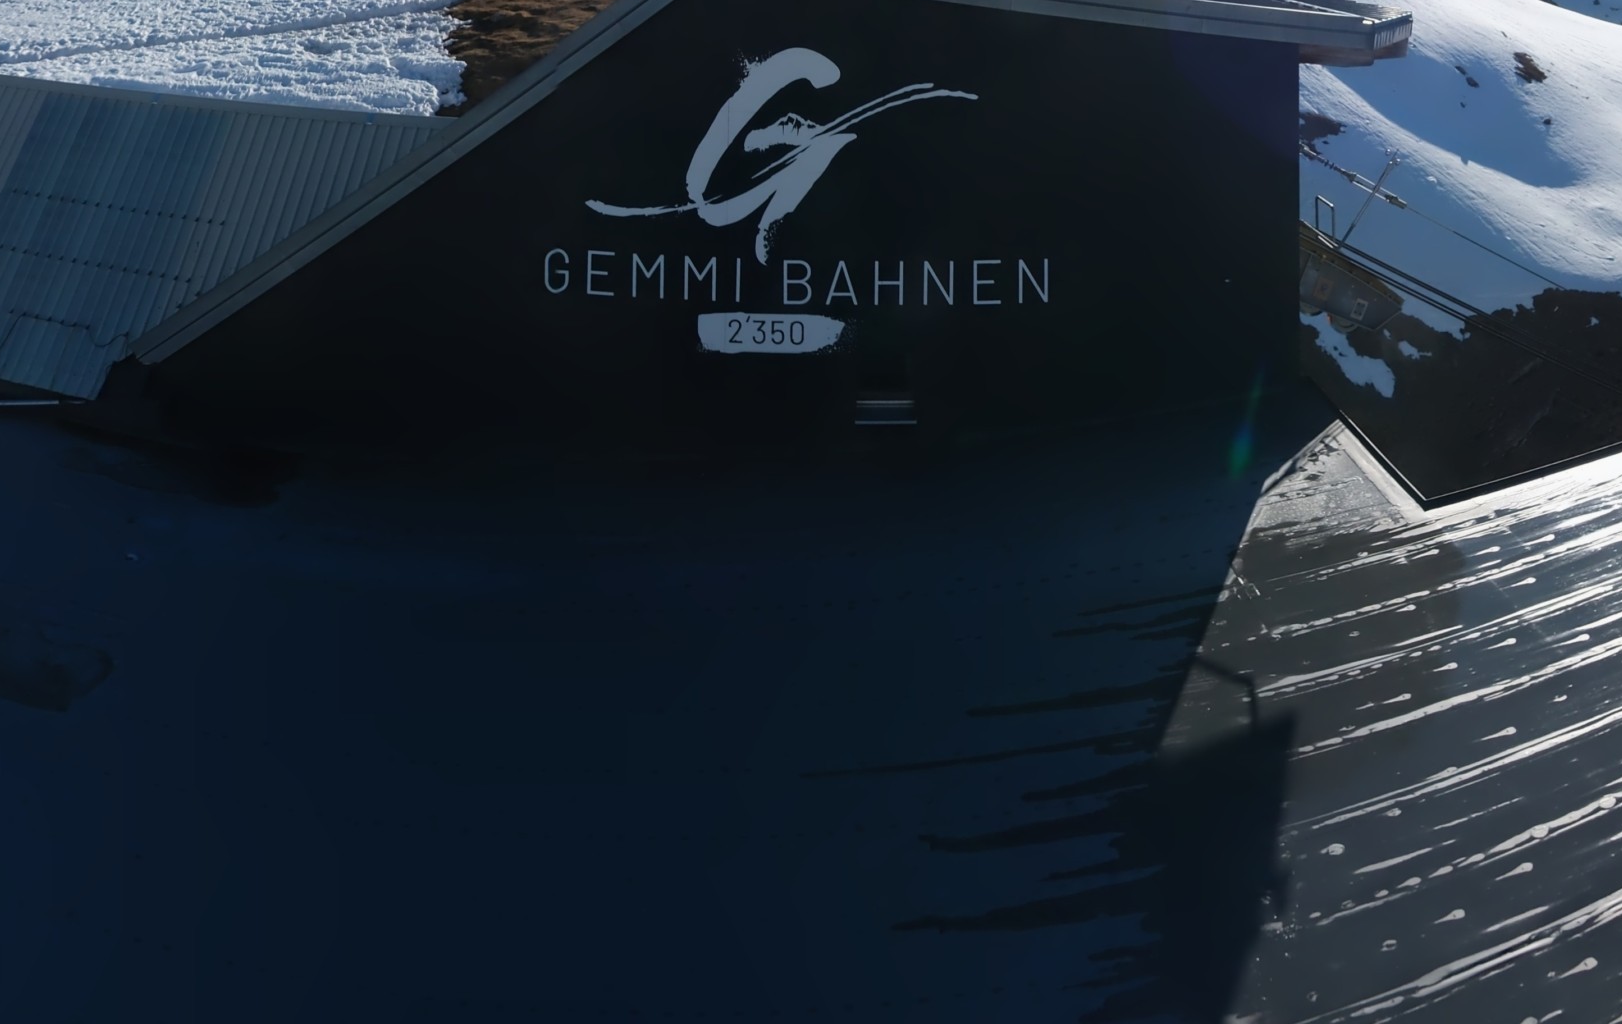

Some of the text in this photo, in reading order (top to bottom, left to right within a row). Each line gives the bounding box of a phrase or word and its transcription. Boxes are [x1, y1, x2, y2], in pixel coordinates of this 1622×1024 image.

[543, 247, 1050, 306] GEMMI BAHNEN
[728, 315, 806, 346] 2'350
